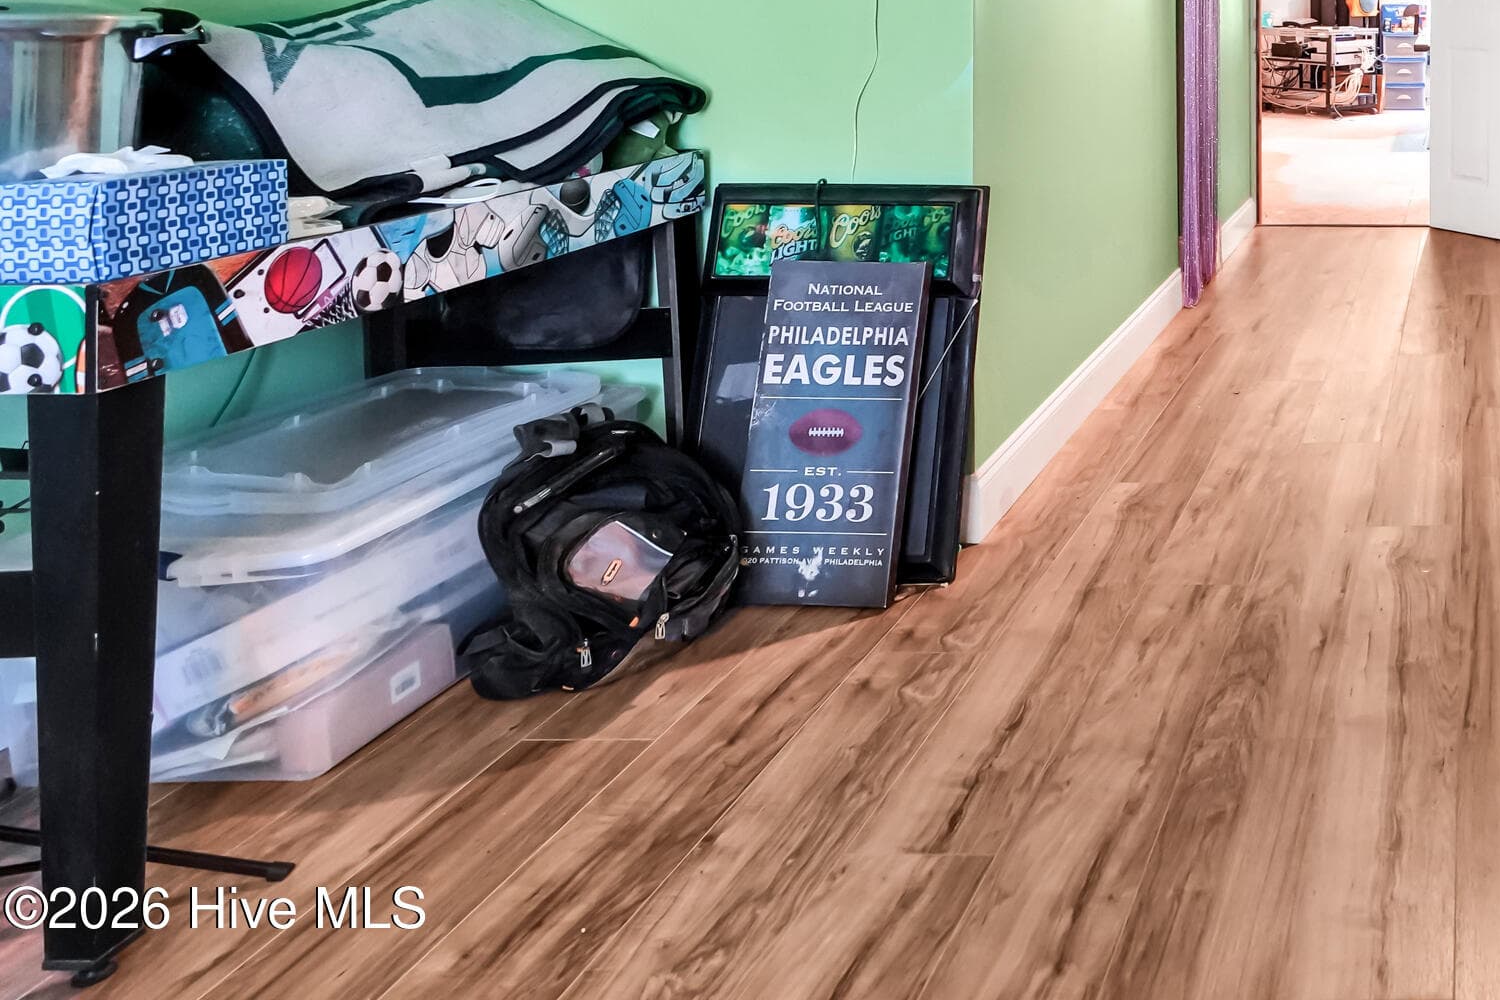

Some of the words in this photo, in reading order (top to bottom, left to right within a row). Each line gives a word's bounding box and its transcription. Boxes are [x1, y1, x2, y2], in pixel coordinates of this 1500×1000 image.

[829, 204, 882, 249] Coors
[808, 283, 883, 296] NATIONAL
[773, 299, 850, 312] FOOTBALL
[854, 300, 914, 313] LEAGUE
[767, 325, 909, 346] PHILADELPHIA
[762, 353, 906, 387] EAGLES
[804, 466, 842, 477] EST.
[760, 483, 875, 523] 1933
[812, 547, 885, 556] WEEKLY
[823, 558, 883, 567] PHILADELPHIA
